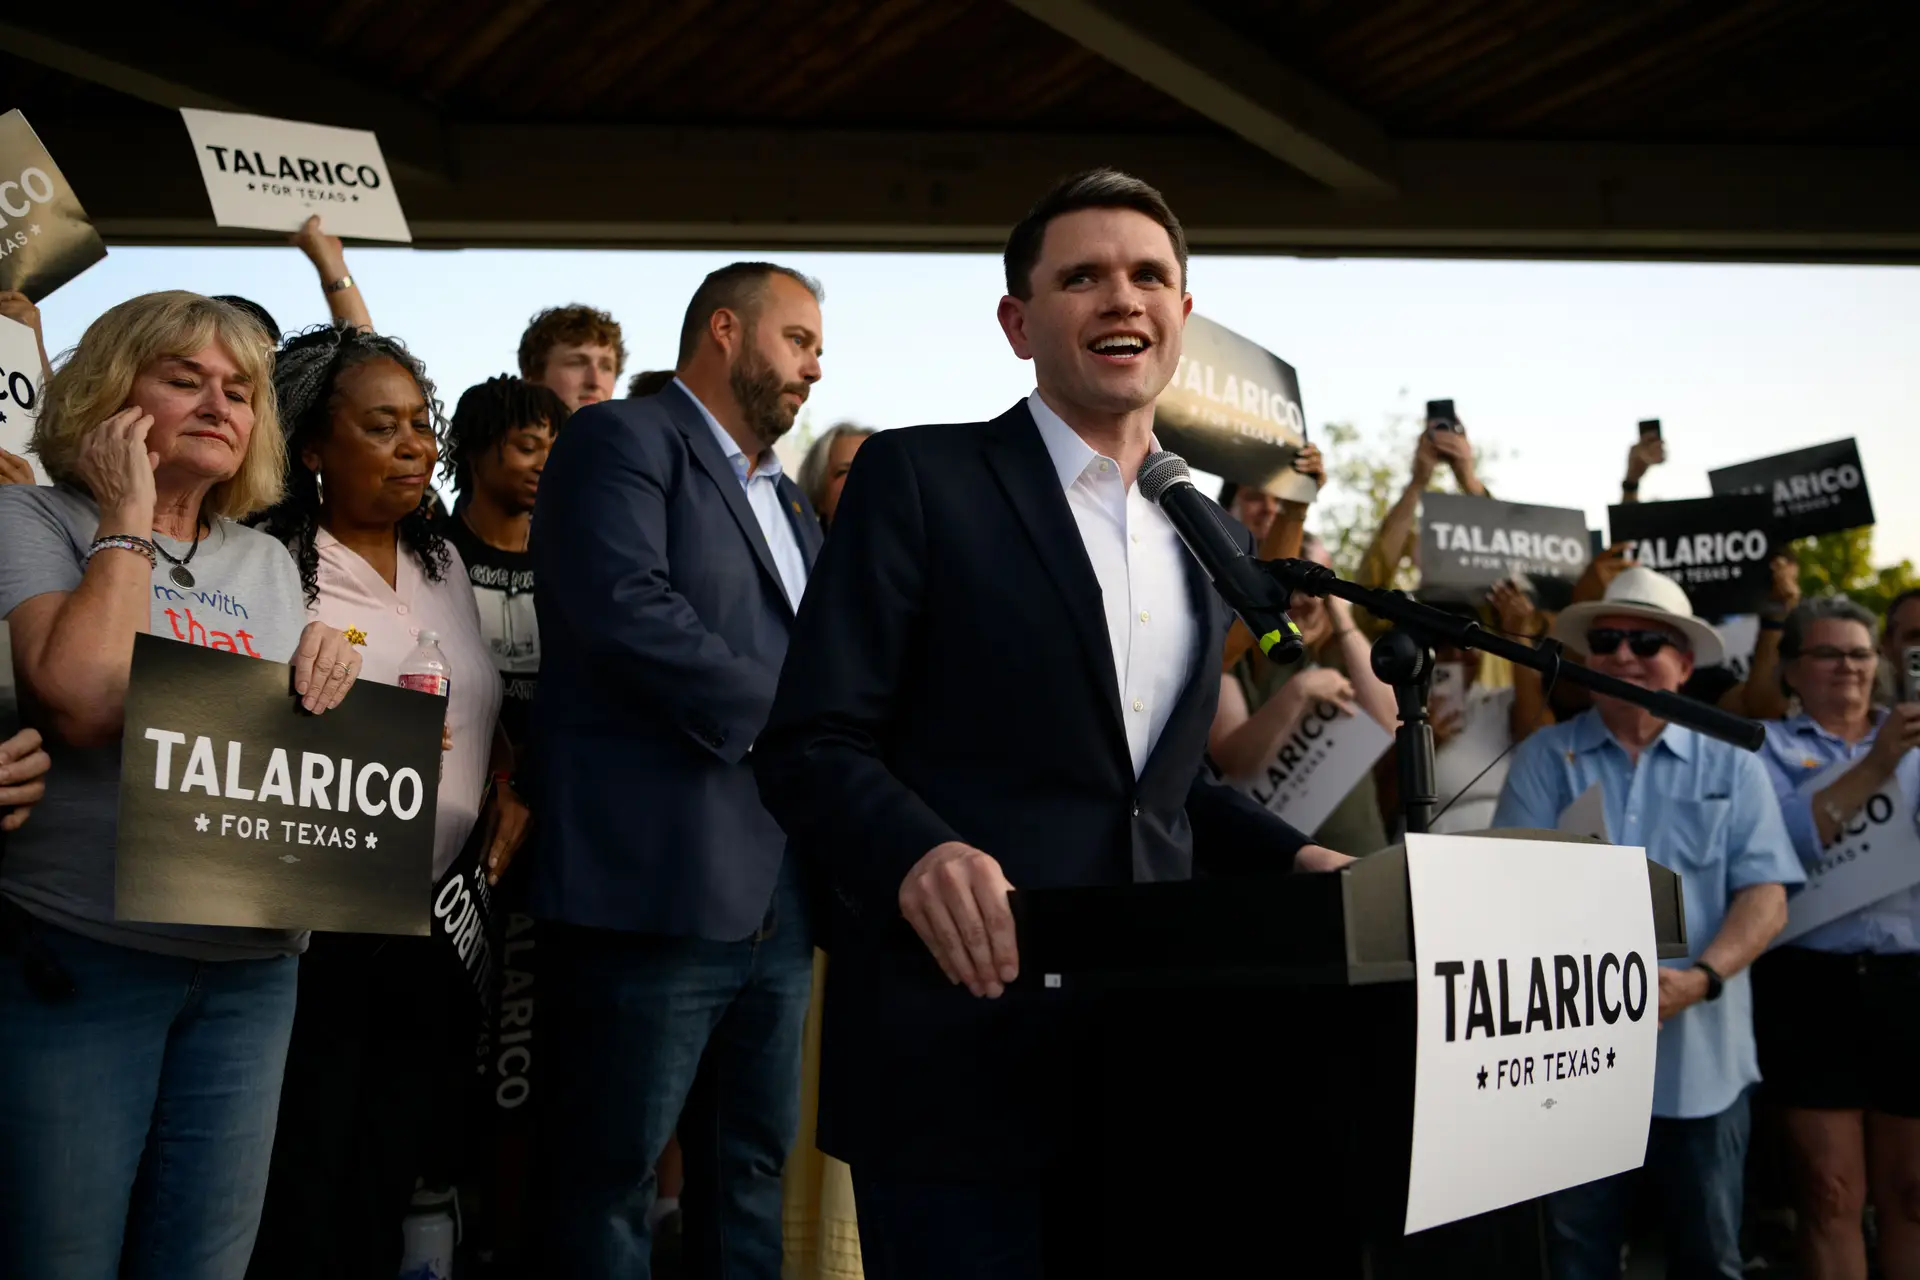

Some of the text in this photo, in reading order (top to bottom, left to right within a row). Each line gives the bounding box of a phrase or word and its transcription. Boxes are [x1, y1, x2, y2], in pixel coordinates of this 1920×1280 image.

[206, 145, 380, 189] TALARICO
[262, 182, 346, 203] FOR TEXAS
[1742, 463, 1861, 506] ARICO
[1429, 522, 1584, 566] TALARICO
[192, 589, 248, 620] with
[164, 607, 261, 658] that
[145, 728, 423, 820] TALARICO
[1252, 699, 1339, 805] LARICO
[221, 814, 357, 849] FOR TEXAS
[496, 912, 536, 1109] ALARICO
[1435, 951, 1648, 1042] TALARICO
[1497, 1046, 1600, 1089] FOR TEXAS
